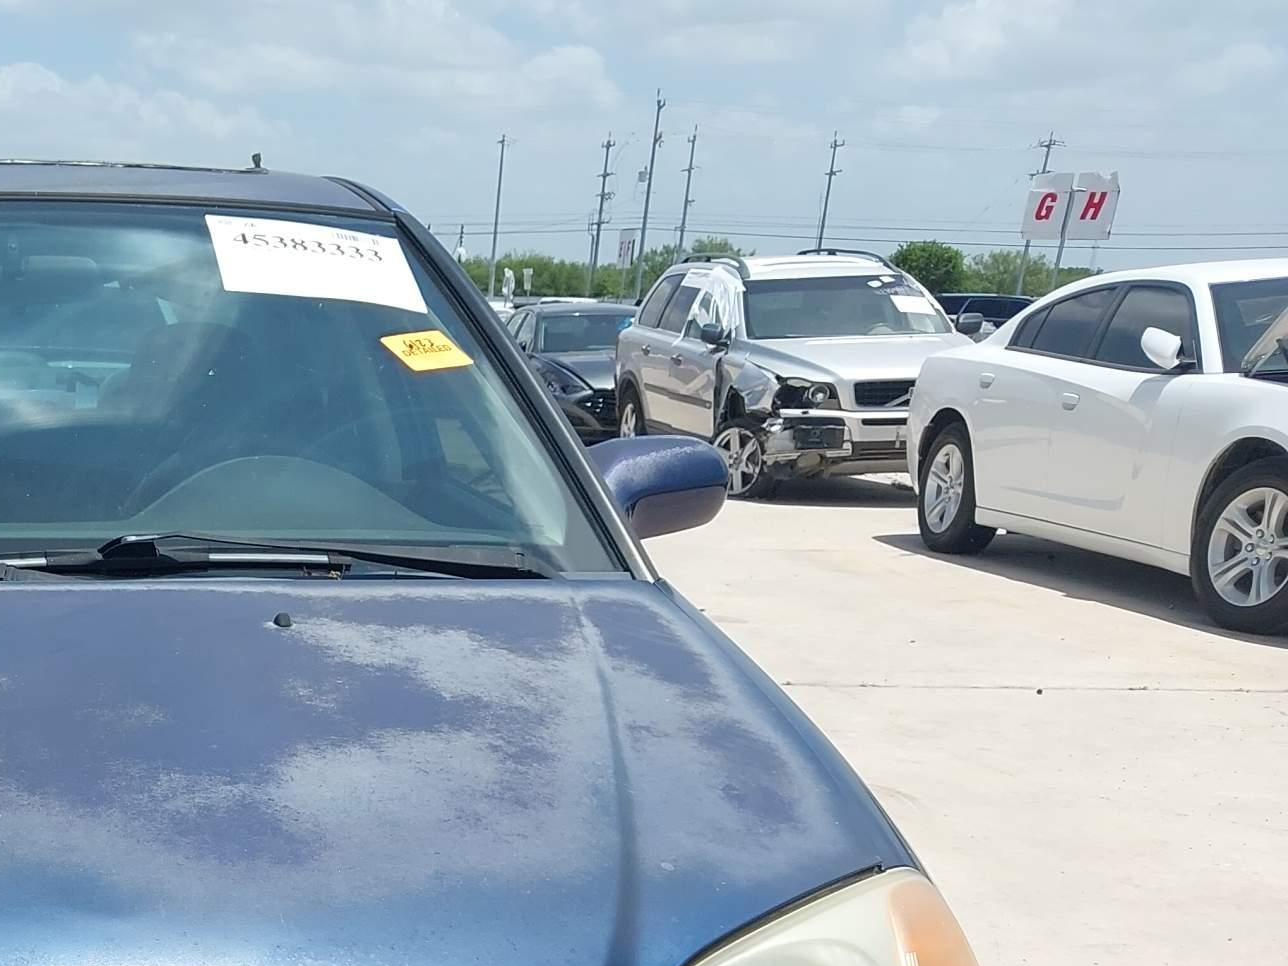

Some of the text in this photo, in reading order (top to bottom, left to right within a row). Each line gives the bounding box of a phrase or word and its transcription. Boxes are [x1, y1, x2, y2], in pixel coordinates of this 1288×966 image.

[1034, 192, 1058, 220] G
[1079, 191, 1108, 220] H
[232, 232, 383, 262] 45383333
